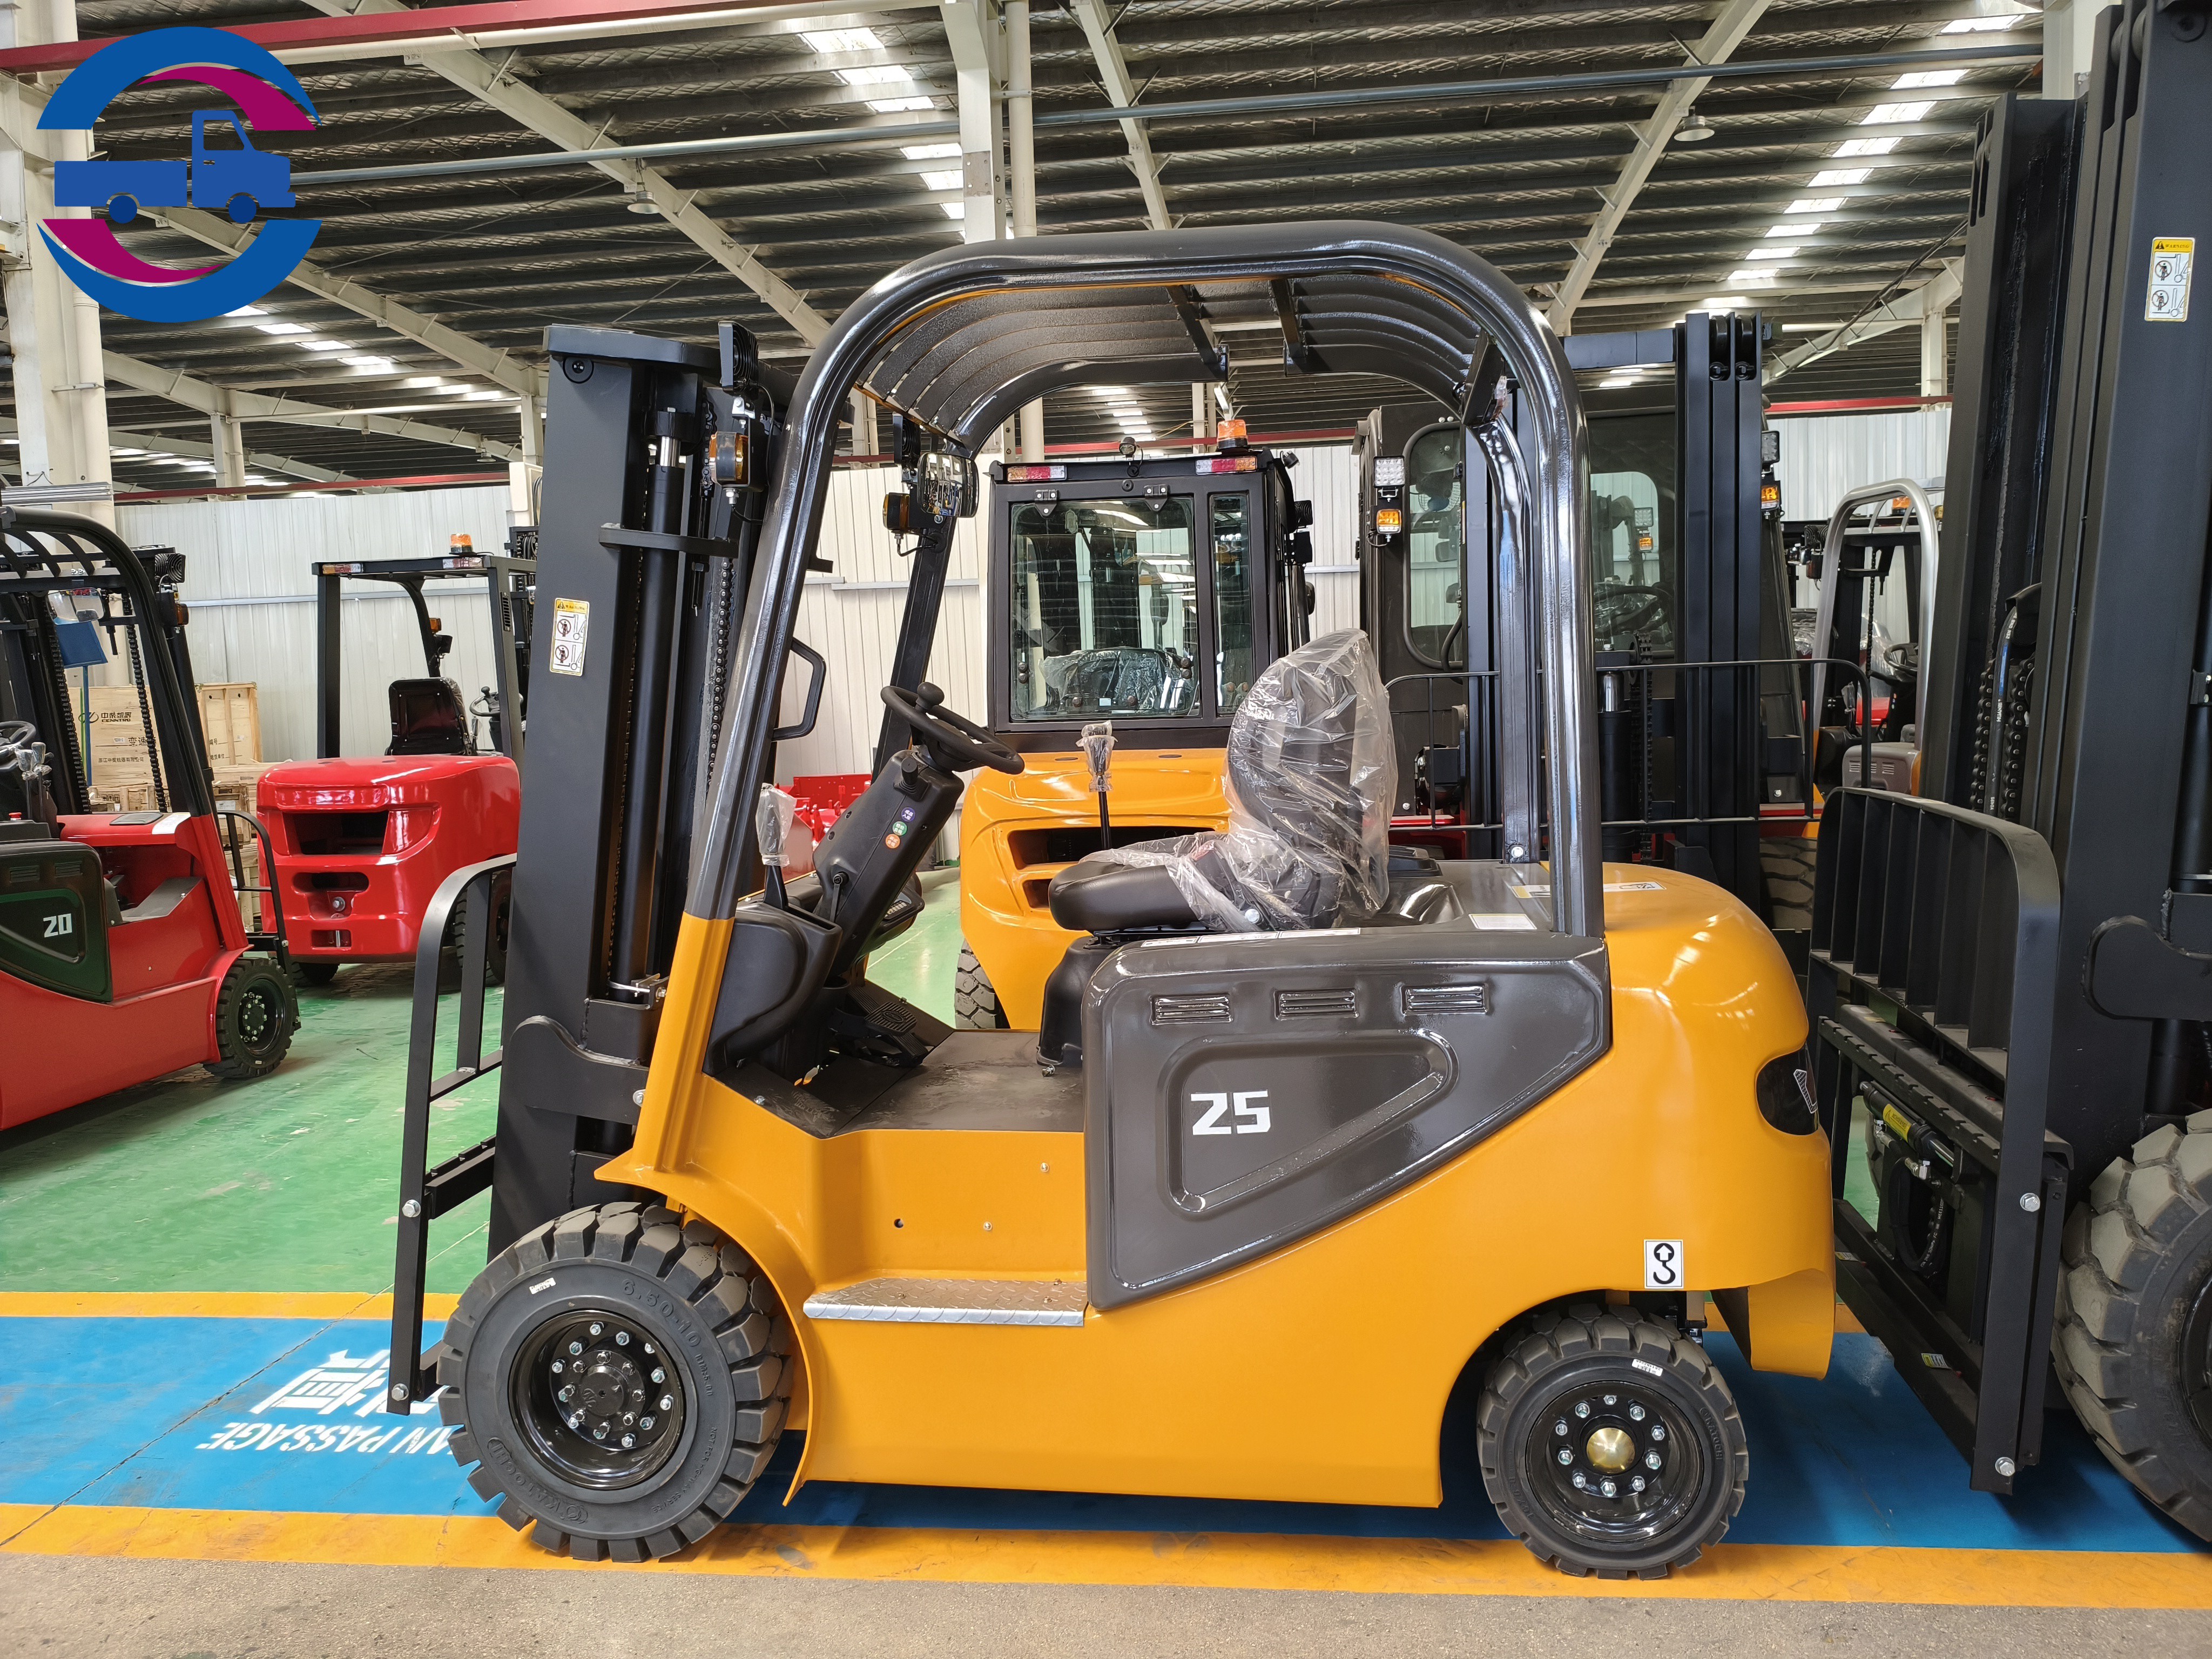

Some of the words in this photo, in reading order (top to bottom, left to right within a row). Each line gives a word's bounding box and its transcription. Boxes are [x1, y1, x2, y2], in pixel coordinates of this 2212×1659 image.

[128, 737, 157, 746] 变速
[43, 913, 72, 938] 20
[1190, 1090, 1271, 1135] 25
[194, 1421, 383, 1453] PASSAGE
[389, 1426, 455, 1455] AN
